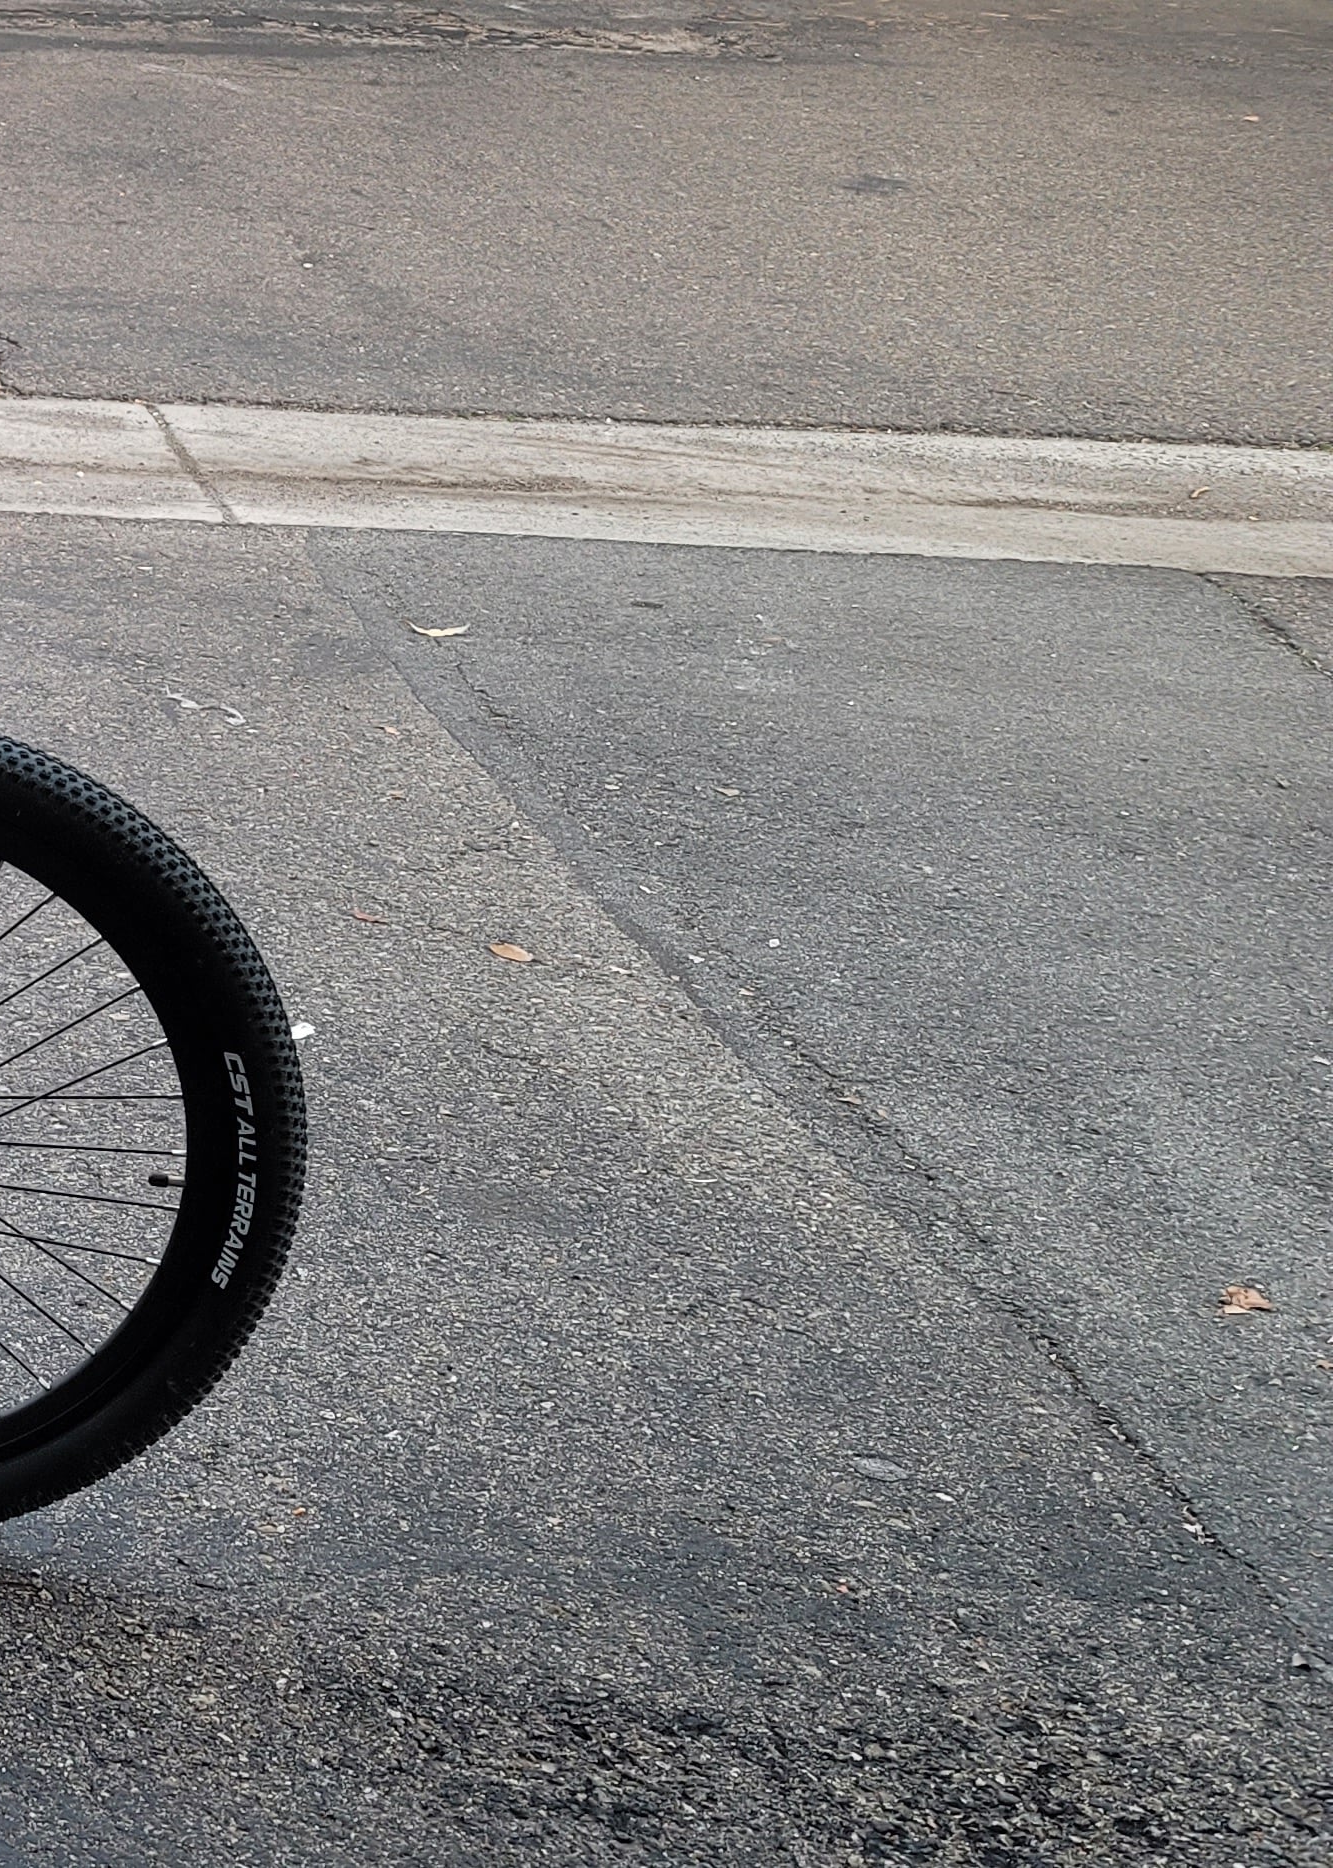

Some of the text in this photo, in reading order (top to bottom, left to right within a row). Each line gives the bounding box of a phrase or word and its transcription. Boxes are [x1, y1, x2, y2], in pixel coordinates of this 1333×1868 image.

[211, 1051, 257, 1290] CST ALL TERRAINS
